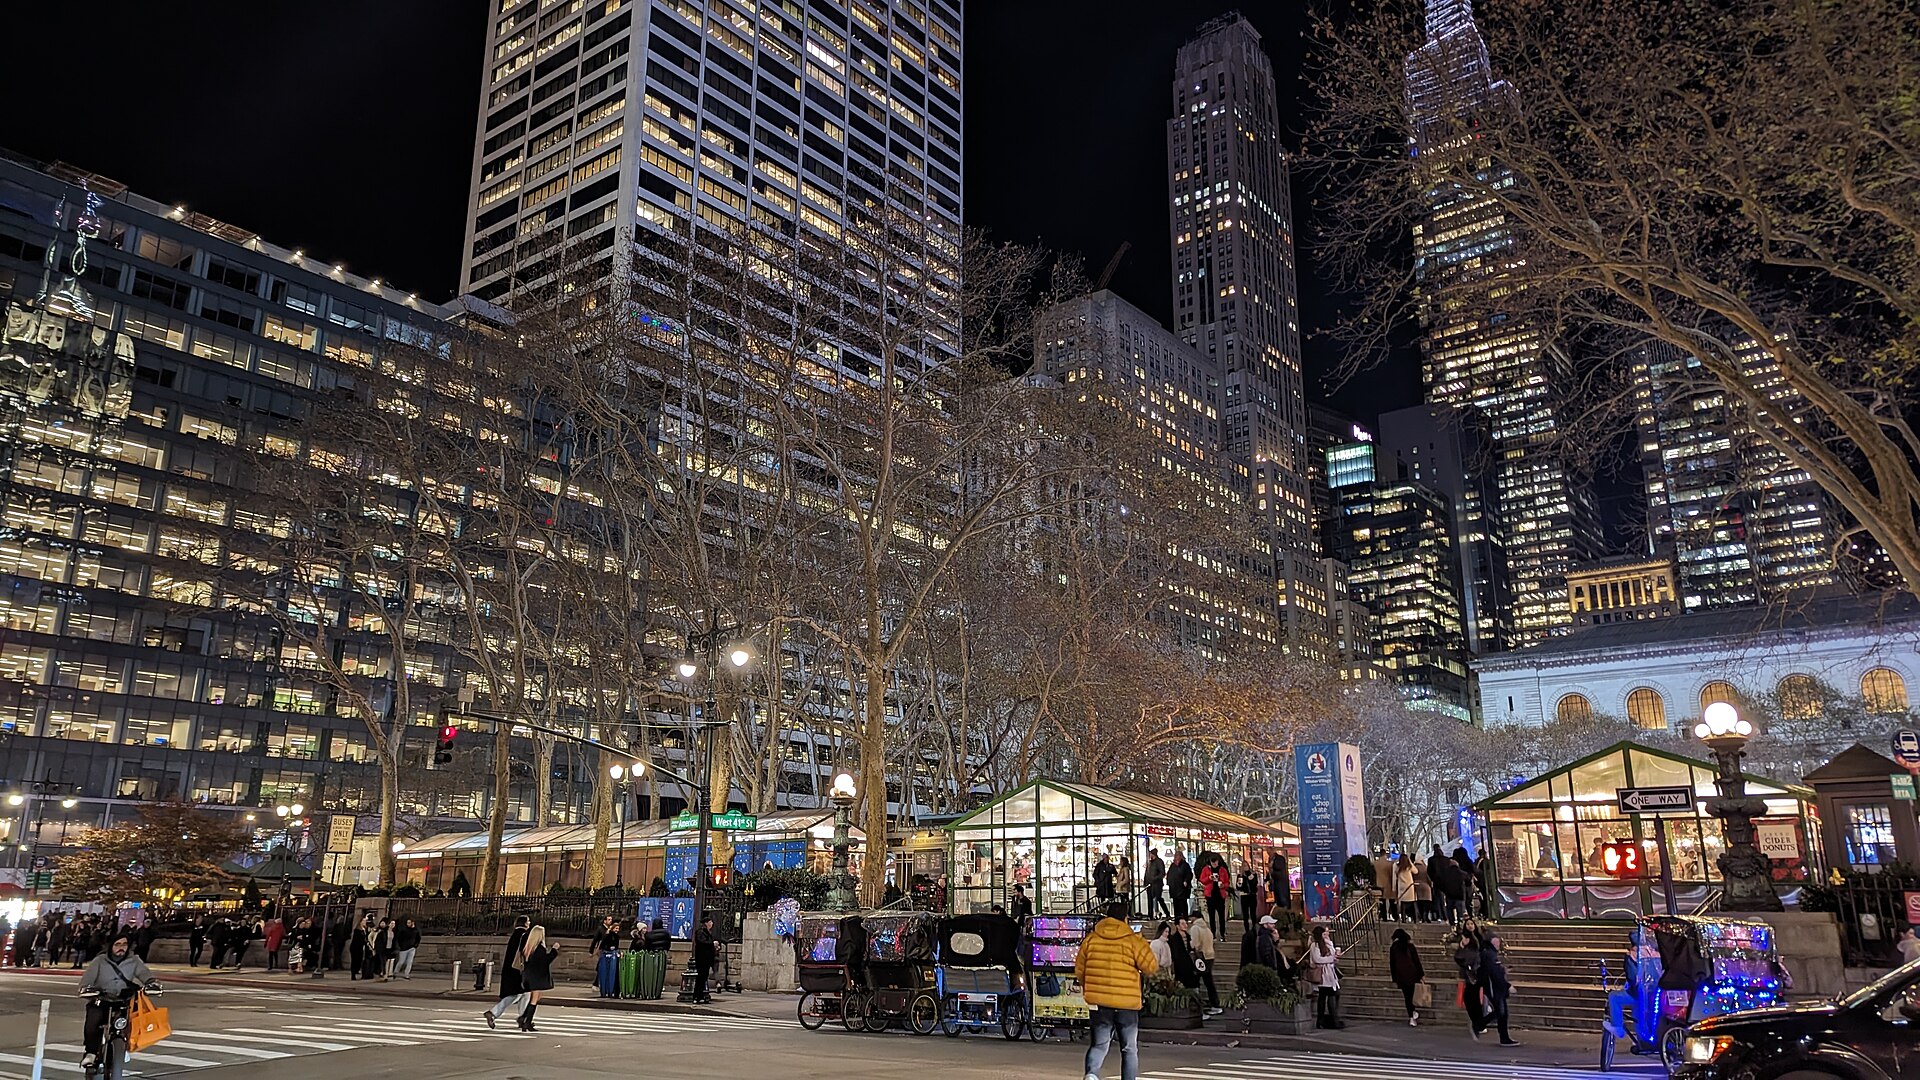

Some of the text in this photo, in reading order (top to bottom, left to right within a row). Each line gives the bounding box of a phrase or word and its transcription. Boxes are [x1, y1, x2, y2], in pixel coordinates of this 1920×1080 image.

[1631, 795, 1680, 804] ONE WAY
[333, 818, 353, 826] BUSES
[678, 818, 698, 827] Americas
[715, 817, 753, 828] West 41st St
[333, 830, 349, 838] ONLY
[1625, 847, 1636, 869] 2
